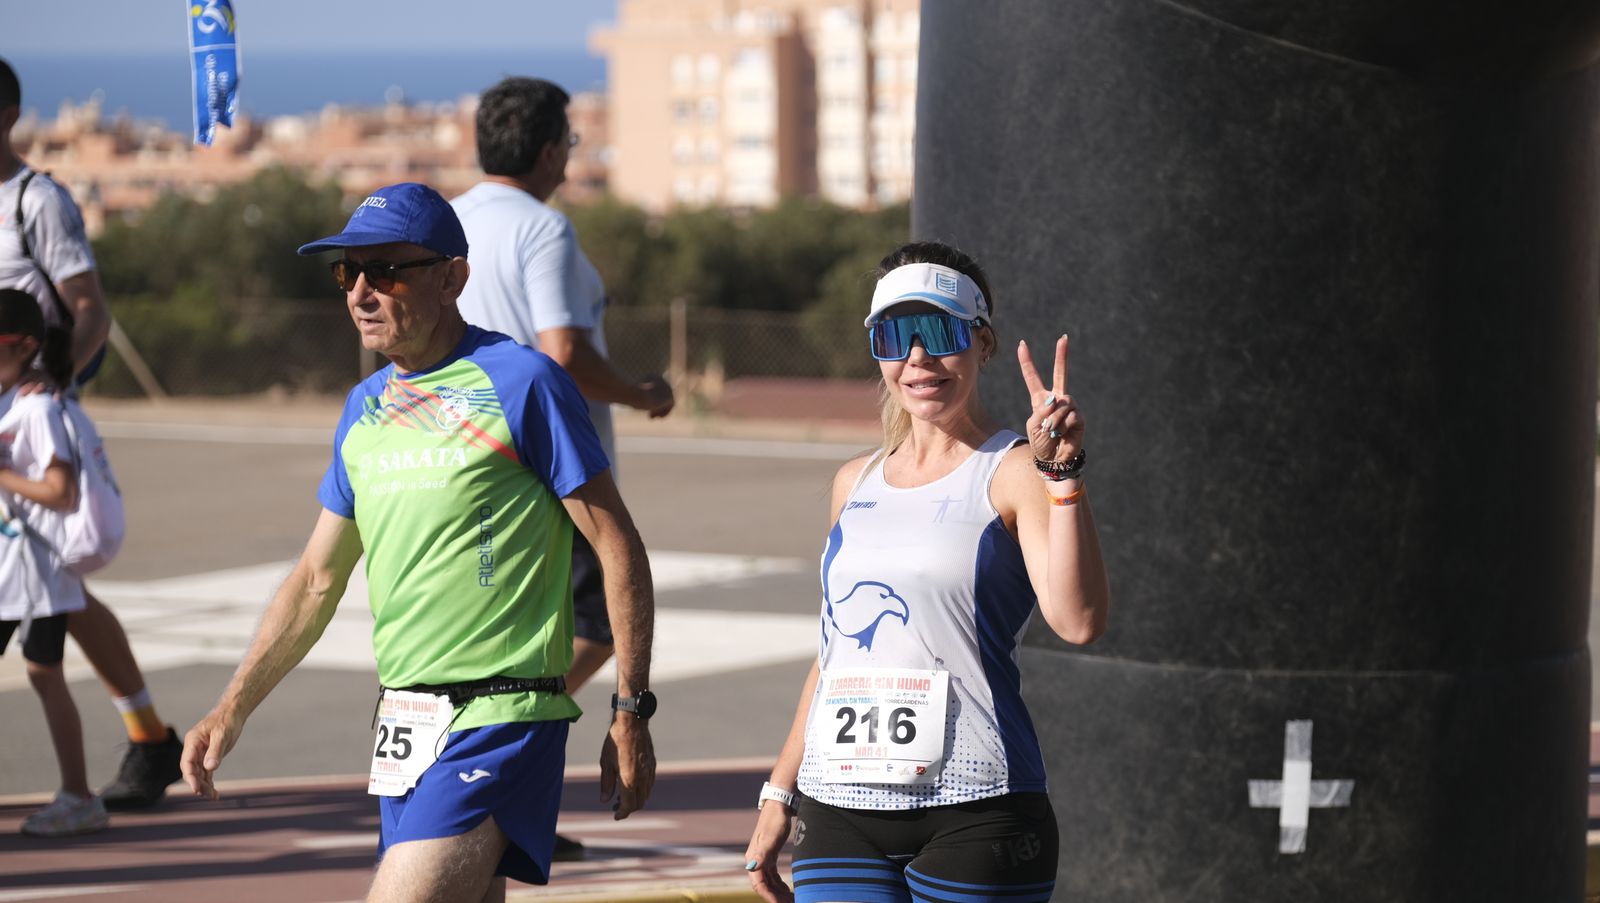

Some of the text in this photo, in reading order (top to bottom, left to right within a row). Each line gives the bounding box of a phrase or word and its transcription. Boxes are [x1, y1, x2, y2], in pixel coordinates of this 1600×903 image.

[357, 196, 387, 209] UEL
[378, 447, 467, 474] SAKATA
[418, 477, 447, 489] Seed
[477, 505, 495, 588] Atletismo
[835, 677, 871, 690] CARRERA
[875, 677, 894, 689] SIN
[897, 677, 931, 691] HUMO
[412, 700, 439, 713] HUMO
[835, 706, 917, 745] 216
[375, 724, 412, 760] 25
